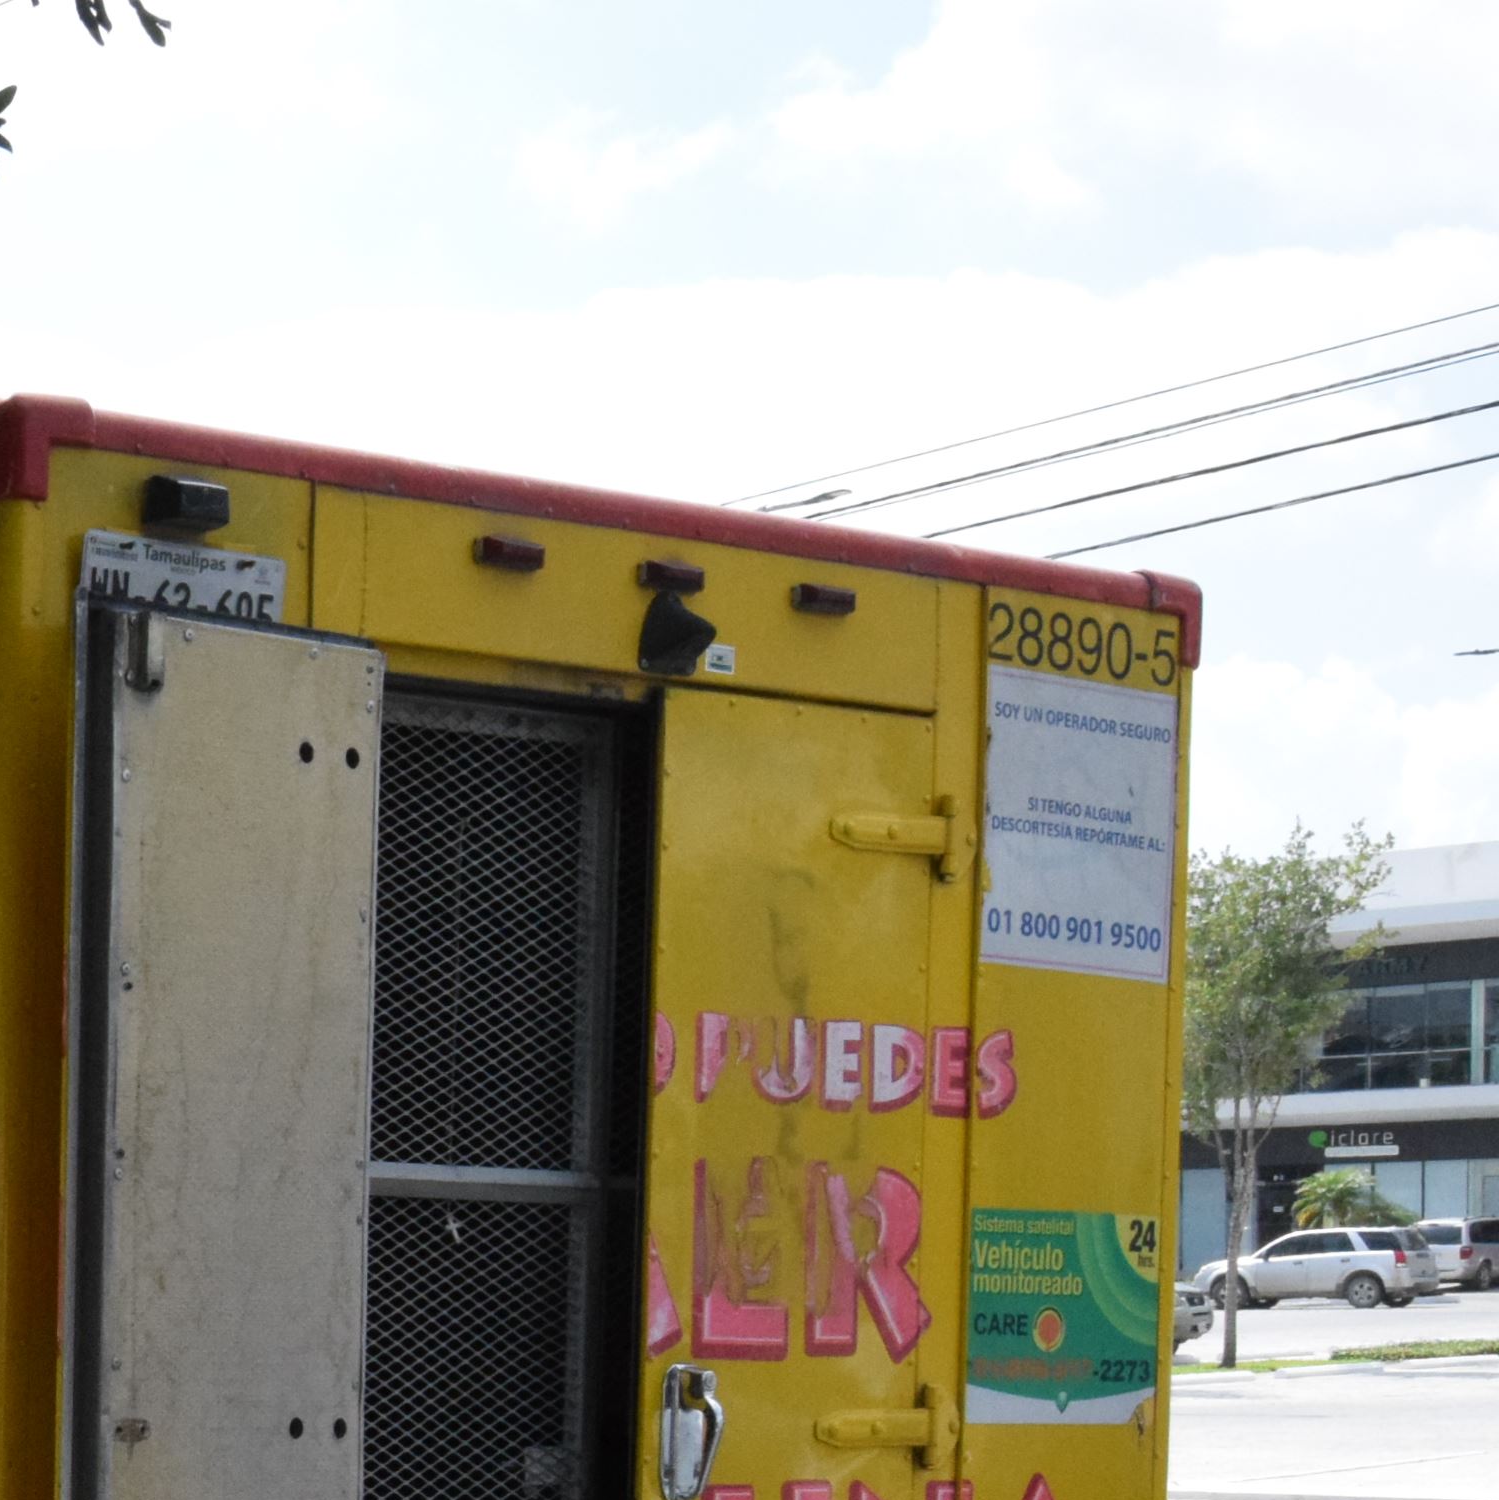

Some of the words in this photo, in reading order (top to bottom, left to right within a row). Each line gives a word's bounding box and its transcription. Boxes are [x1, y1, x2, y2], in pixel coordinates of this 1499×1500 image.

[143, 544, 226, 573] Tamaulipas
[988, 602, 1177, 687] 28890-5
[994, 701, 1021, 719] SOY
[1024, 706, 1043, 723] UN
[1046, 710, 1116, 735] OPERADOR
[1119, 721, 1172, 743] SEGURO
[1028, 797, 1039, 811] SI
[1040, 798, 1082, 817] TENGO
[1084, 805, 1132, 824] ALGUNA
[1147, 837, 1166, 852] AL:
[988, 907, 1012, 934] 01
[1020, 911, 1060, 939] 800
[1066, 916, 1103, 945] 901
[1111, 922, 1161, 952] 9500
[1331, 1129, 1394, 1146] iclare
[974, 1214, 1024, 1233] Sistema
[1027, 1218, 1075, 1236] satelital
[1130, 1219, 1157, 1252] 24
[975, 1239, 1064, 1271] Vehículo
[973, 1271, 1083, 1296] monitoreado
[974, 1313, 1028, 1336] CARE
